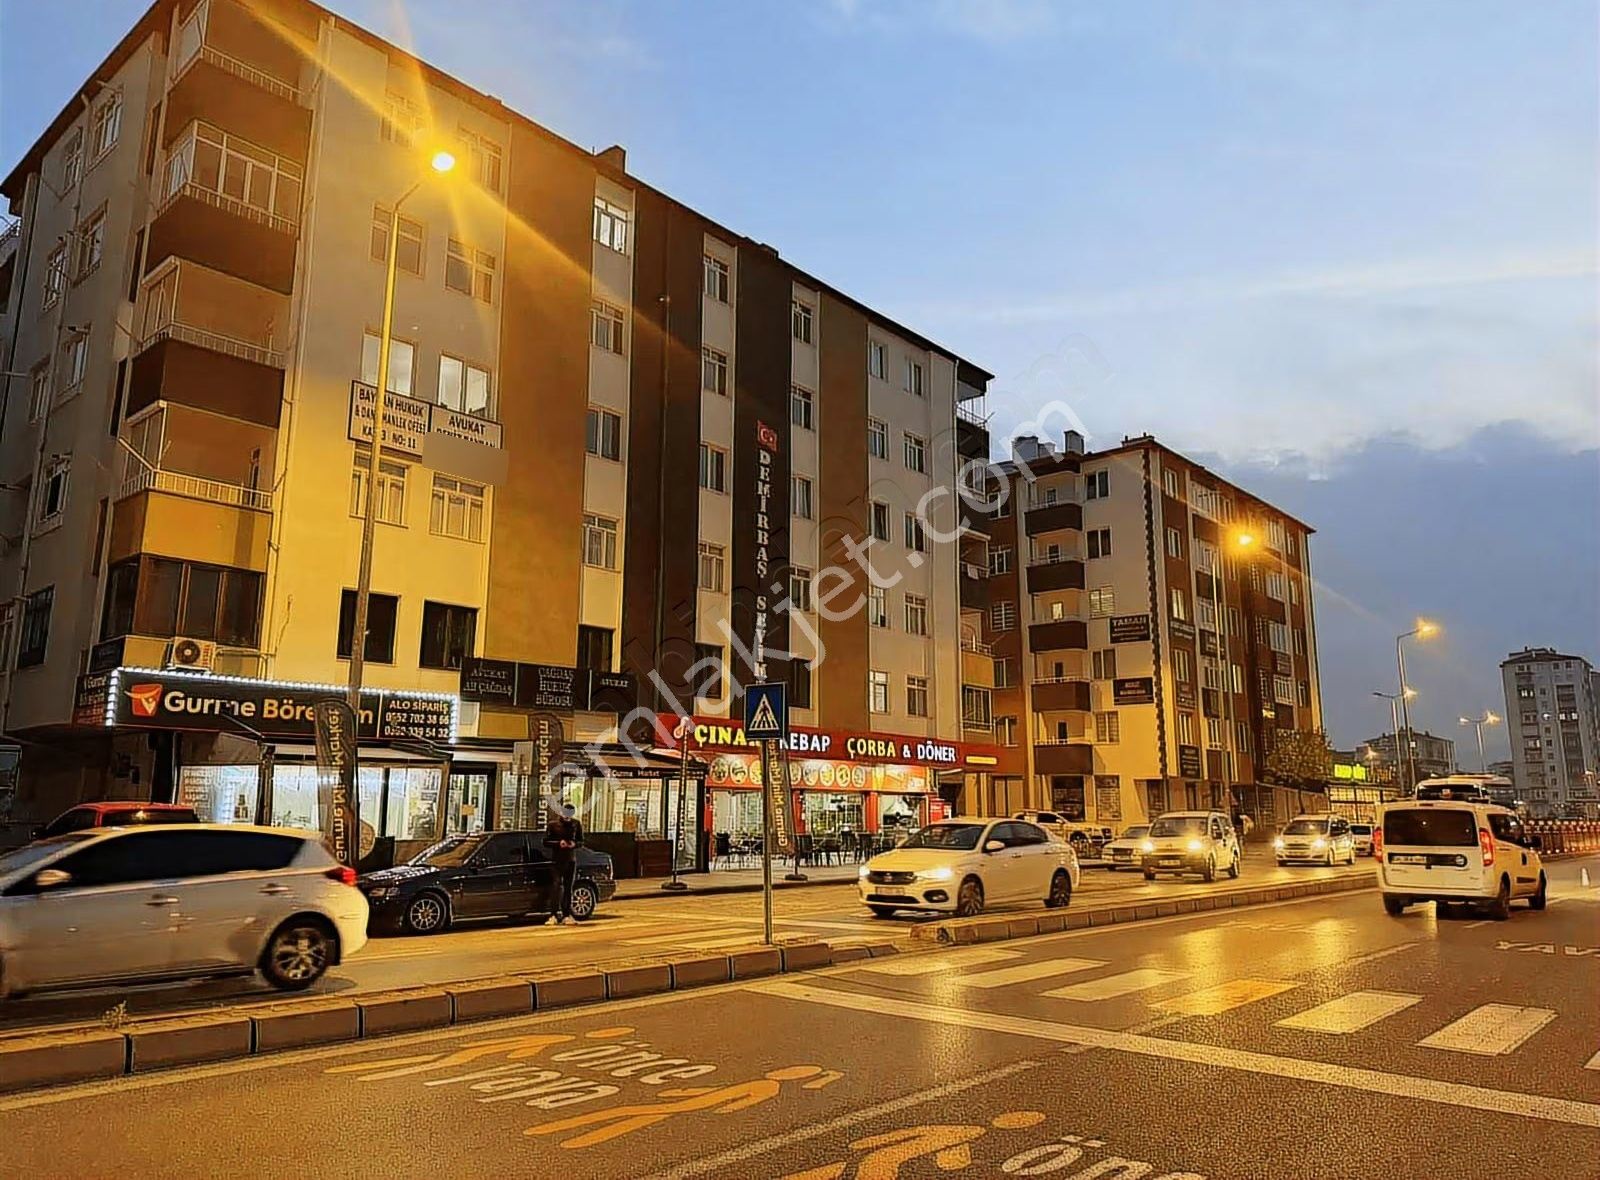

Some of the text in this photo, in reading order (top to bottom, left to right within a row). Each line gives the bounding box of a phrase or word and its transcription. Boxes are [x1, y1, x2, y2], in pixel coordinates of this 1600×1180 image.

[359, 388, 424, 418] BAYAN HUKUK
[449, 415, 486, 436] AVUKAT
[756, 449, 771, 579] DEMİRBAŞ
[164, 690, 374, 724] Gurme Börem
[389, 699, 449, 714] ALO SİPARİŞ
[694, 724, 762, 748] ÇINA
[846, 737, 956, 762] ÇORBA & DÖNER
